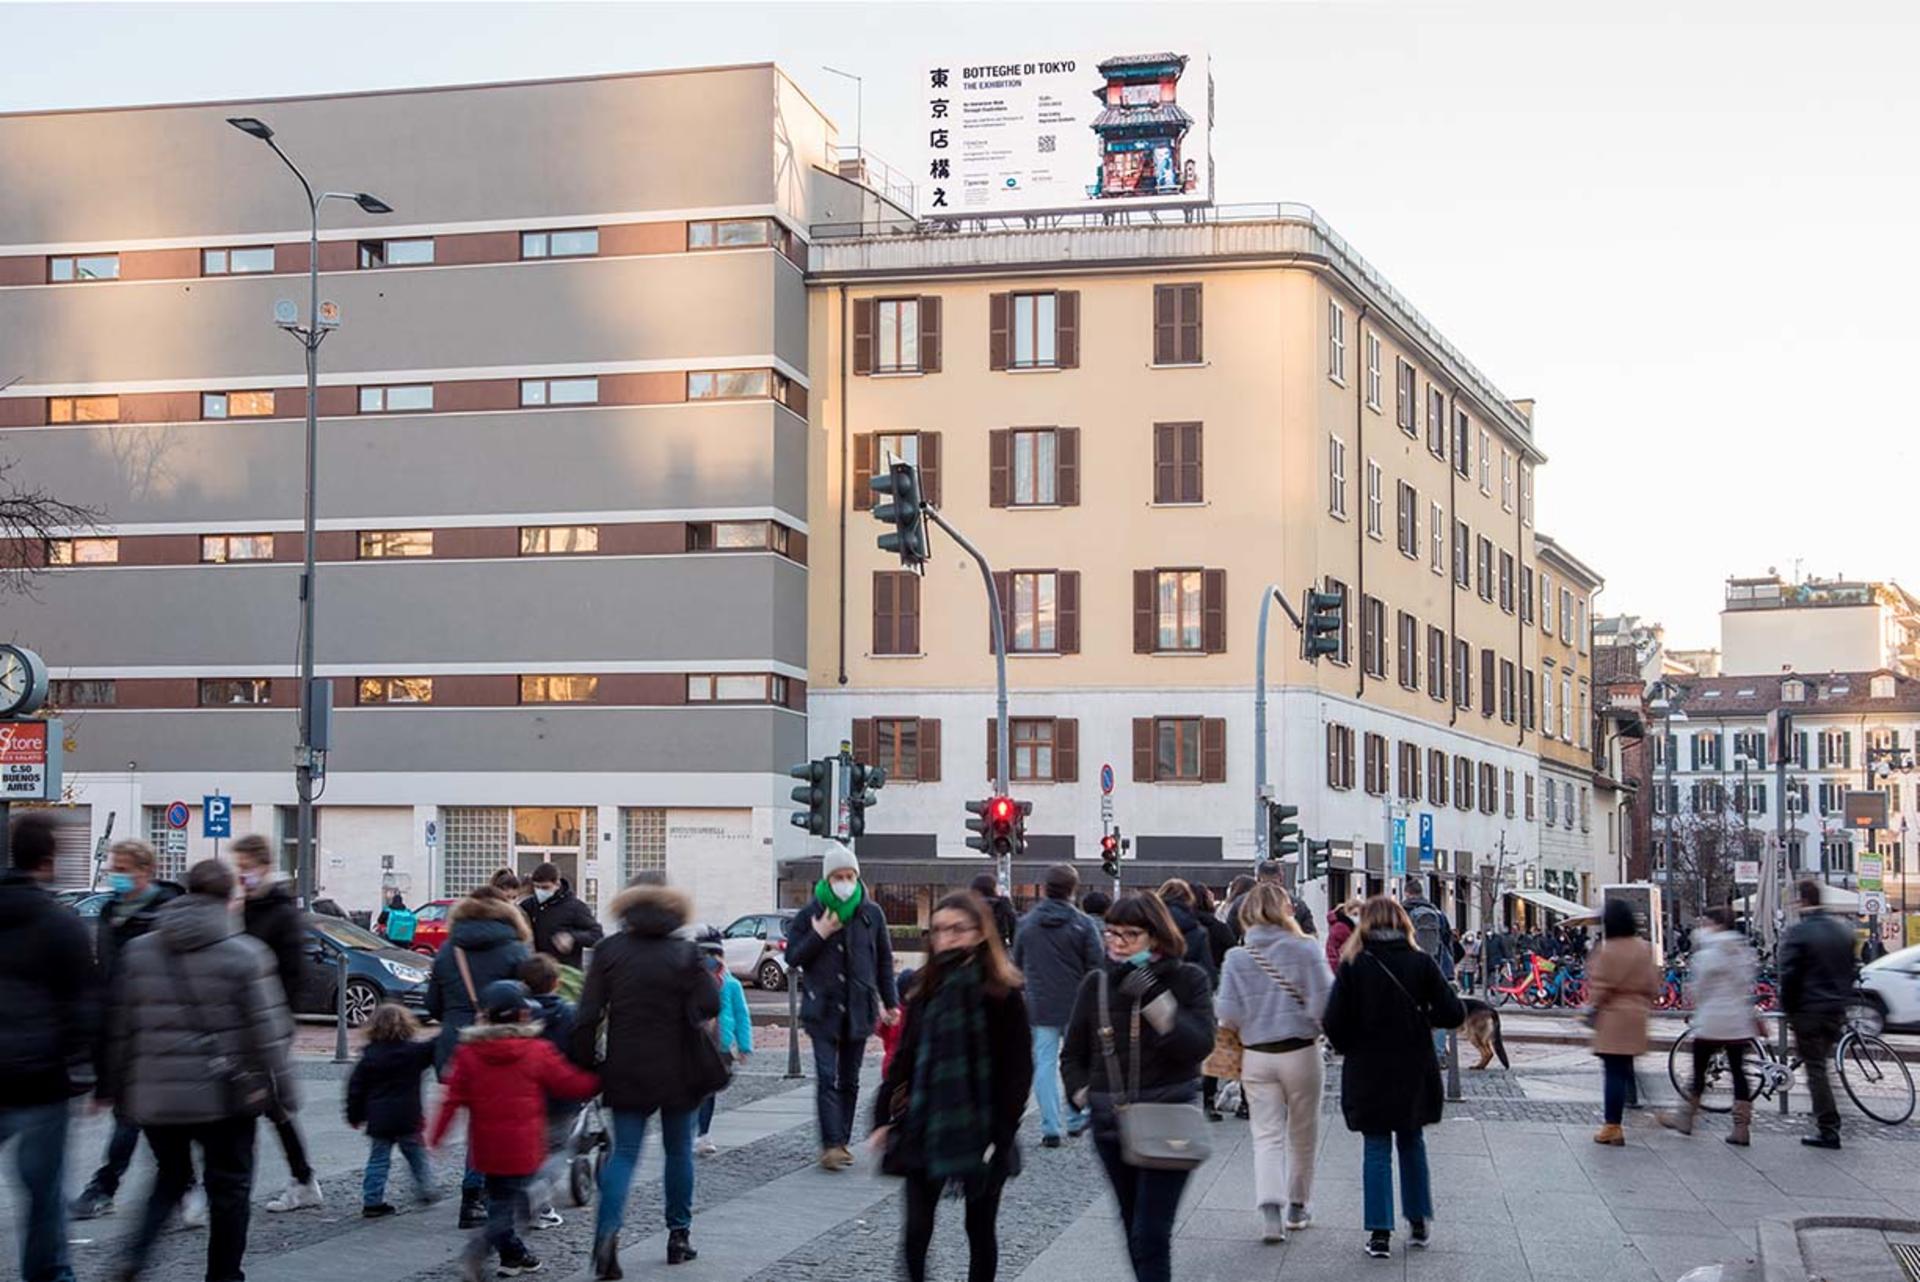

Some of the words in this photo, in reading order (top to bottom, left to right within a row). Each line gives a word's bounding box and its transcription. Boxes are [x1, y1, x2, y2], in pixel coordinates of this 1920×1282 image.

[963, 64, 1021, 79] BOTTEGHE
[1023, 63, 1036, 75] DI
[1038, 60, 1076, 74] TOKYO
[963, 82, 978, 90] THE
[980, 80, 1022, 89] EXHIBITION
[11, 765, 32, 773] C.SO
[3, 774, 41, 782] BUENOS
[7, 783, 36, 792] AIRES
[209, 800, 225, 822] P
[1422, 816, 1430, 838] P
